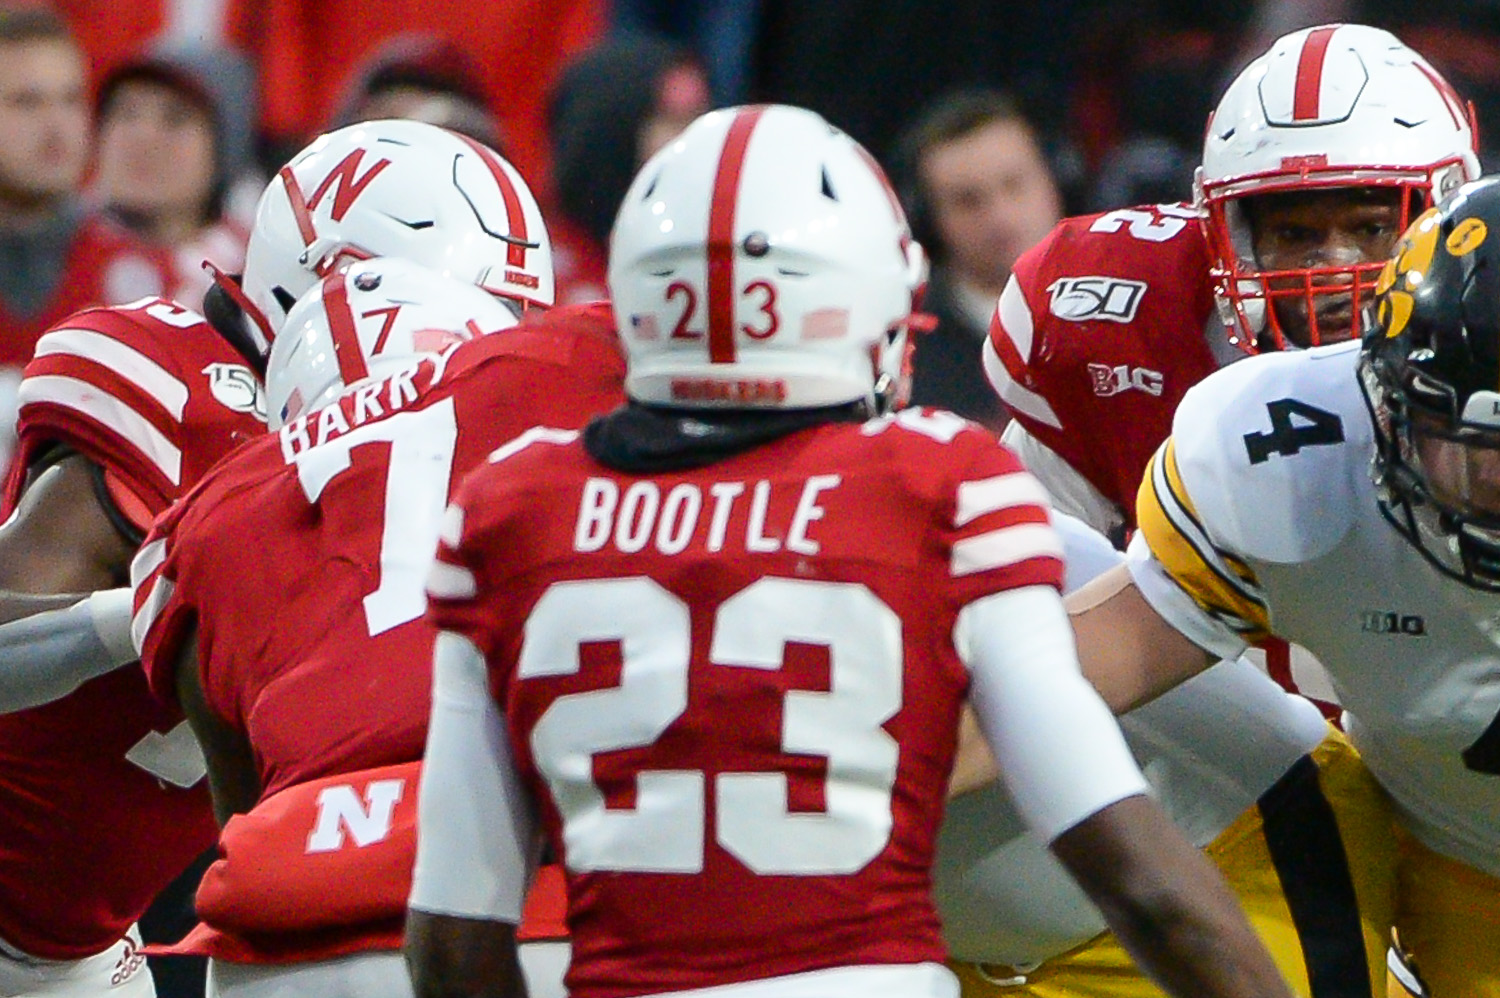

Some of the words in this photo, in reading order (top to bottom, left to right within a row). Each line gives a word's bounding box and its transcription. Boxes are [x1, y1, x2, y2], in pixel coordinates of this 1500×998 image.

[361, 305, 401, 358] 7
[1053, 277, 1145, 320] 150
[1244, 398, 1345, 465] 4
[294, 396, 459, 637] 7
[574, 474, 843, 556] BOOTLE
[517, 575, 903, 875] 23
[305, 779, 405, 854] N
